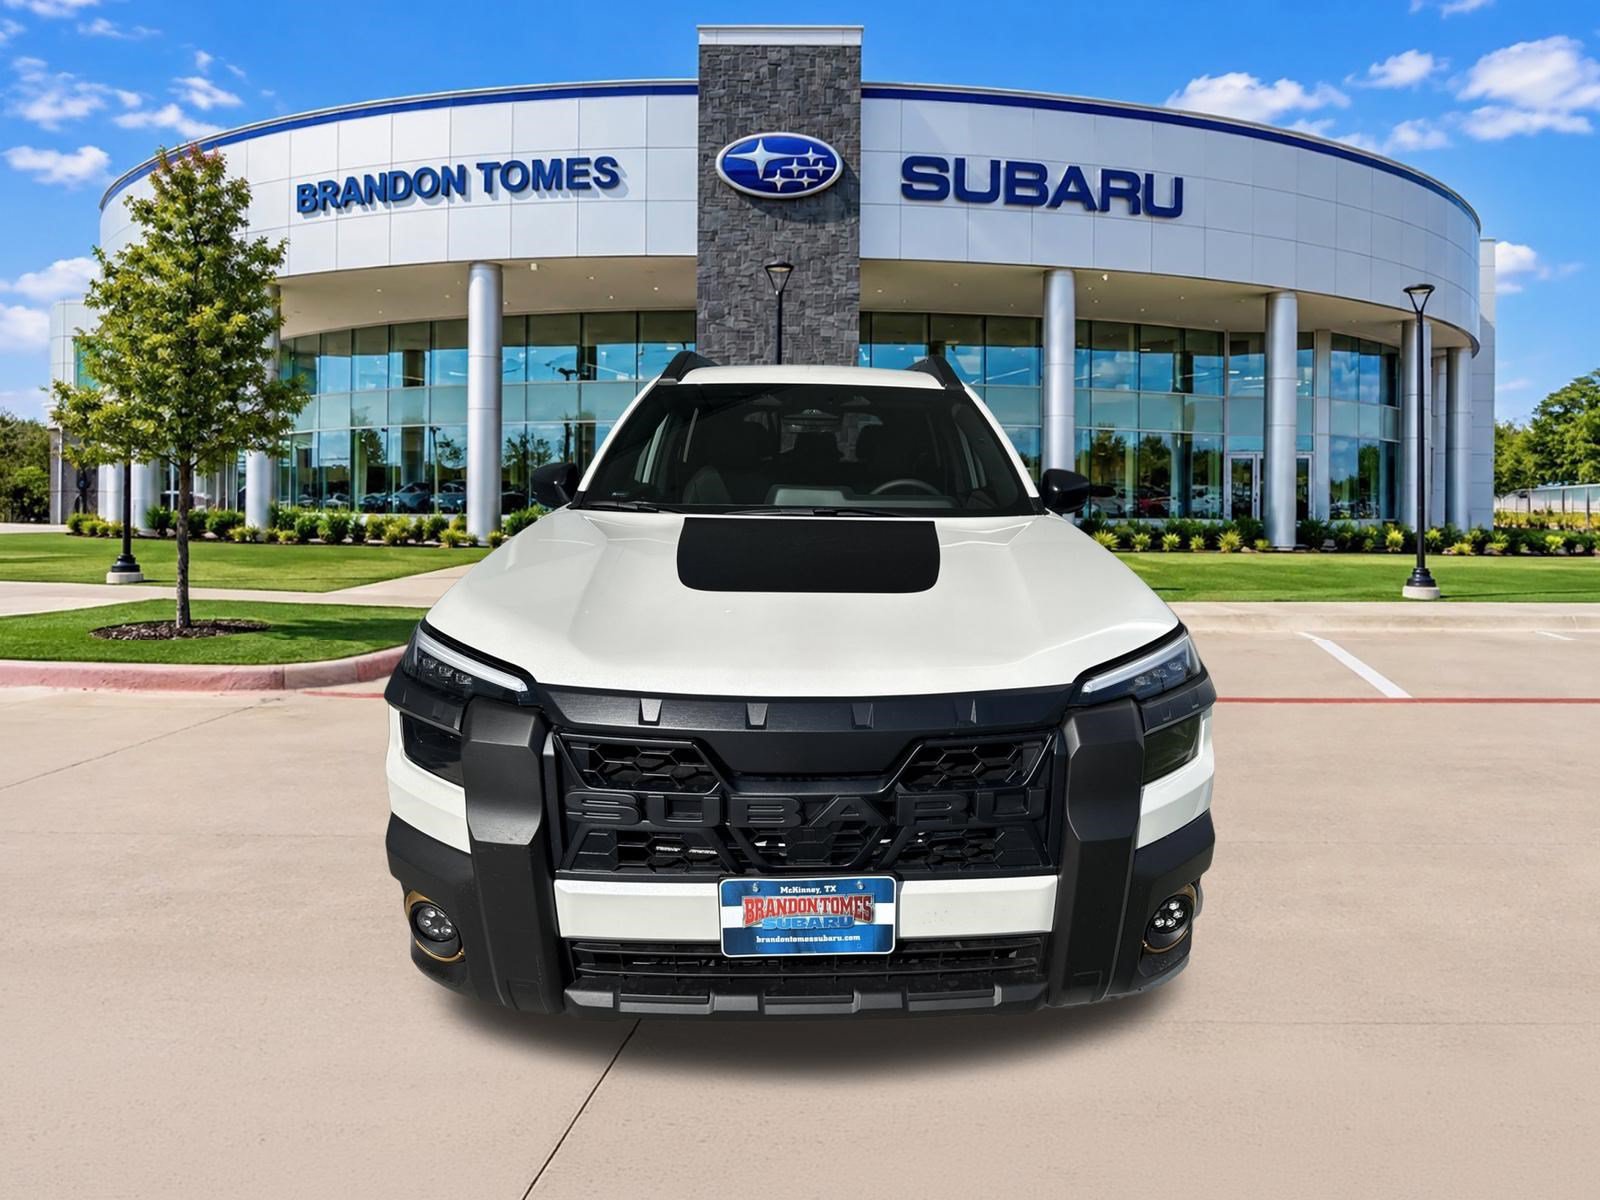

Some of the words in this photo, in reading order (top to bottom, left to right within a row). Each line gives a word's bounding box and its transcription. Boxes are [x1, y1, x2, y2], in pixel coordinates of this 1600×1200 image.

[297, 164, 466, 214] BRANDON
[476, 156, 621, 194] TOMES
[901, 155, 1184, 218] SUBARU
[565, 788, 1045, 828] SUBARU
[780, 886, 822, 895] McKinney,
[824, 885, 837, 893] TX
[744, 897, 819, 926] BRANDON
[821, 895, 874, 922] TOMES
[763, 916, 854, 929] SUBARU
[756, 935, 861, 943] brandontomessubaru.com
